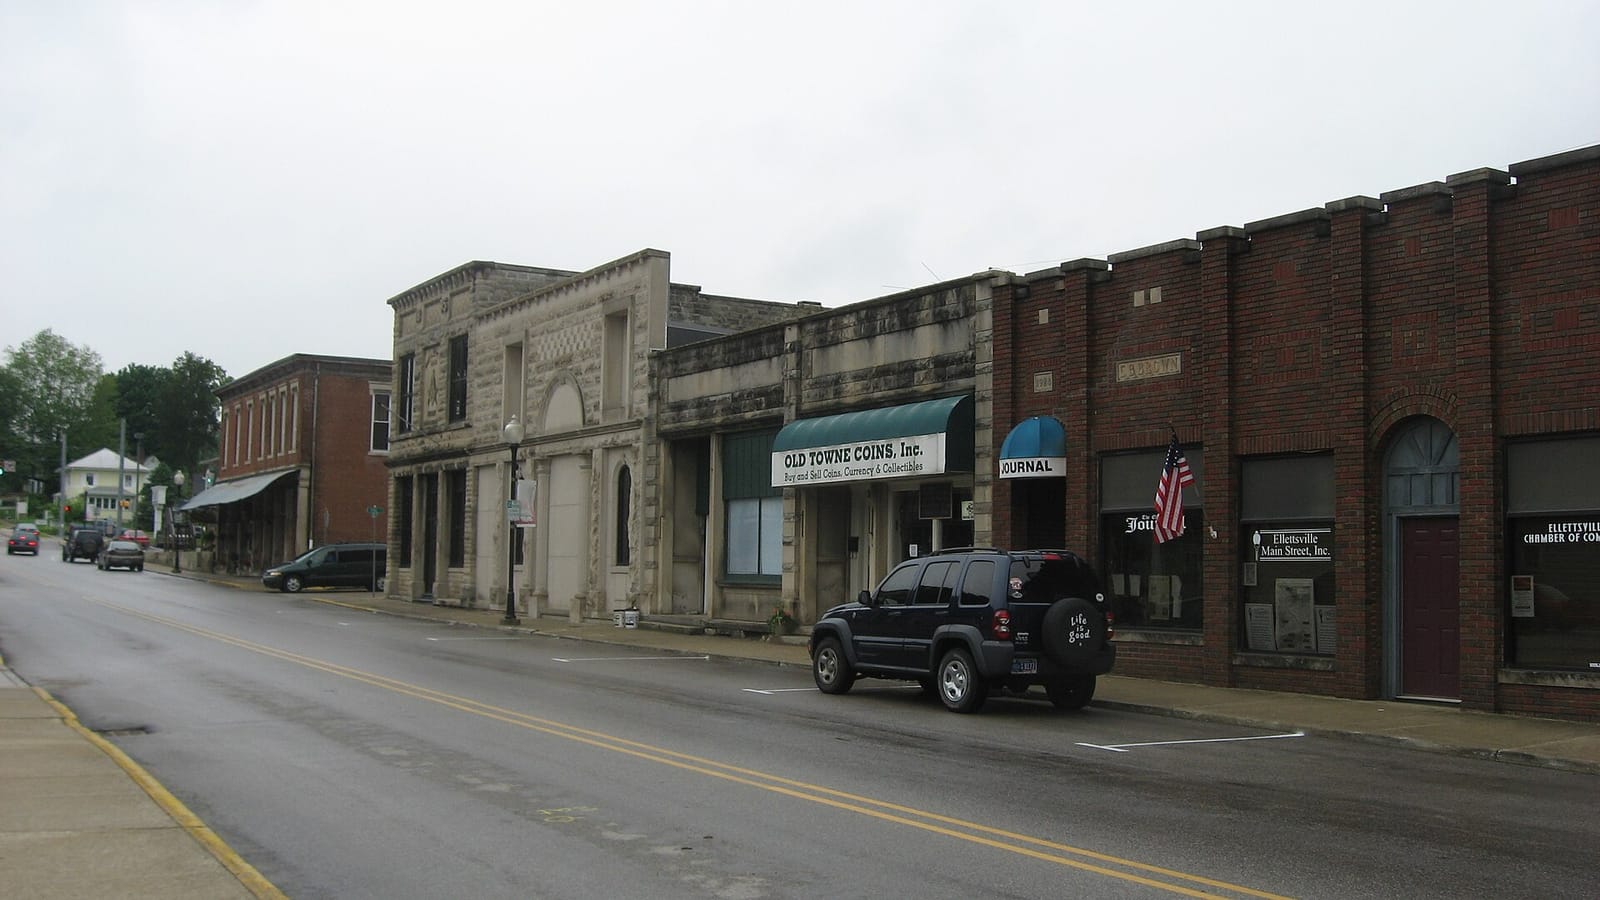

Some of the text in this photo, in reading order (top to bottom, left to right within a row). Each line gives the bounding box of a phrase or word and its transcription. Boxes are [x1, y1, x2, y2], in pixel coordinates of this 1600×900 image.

[784, 442, 923, 468] OLD TOWNE COINS, Inc.
[784, 472, 796, 483] Buy
[797, 471, 809, 480] and
[810, 469, 822, 480] Sell
[844, 466, 874, 477] Currency
[876, 465, 881, 473] &
[883, 460, 923, 473] Collectibles
[1001, 460, 1053, 474] JOURNAL
[1273, 533, 1318, 545] Ellettsville
[1523, 533, 1565, 543] CHAMBER
[1568, 532, 1580, 543] OF
[1261, 545, 1331, 557] Main Street, Inc.
[1070, 613, 1087, 627] Life
[1069, 630, 1090, 643] good
